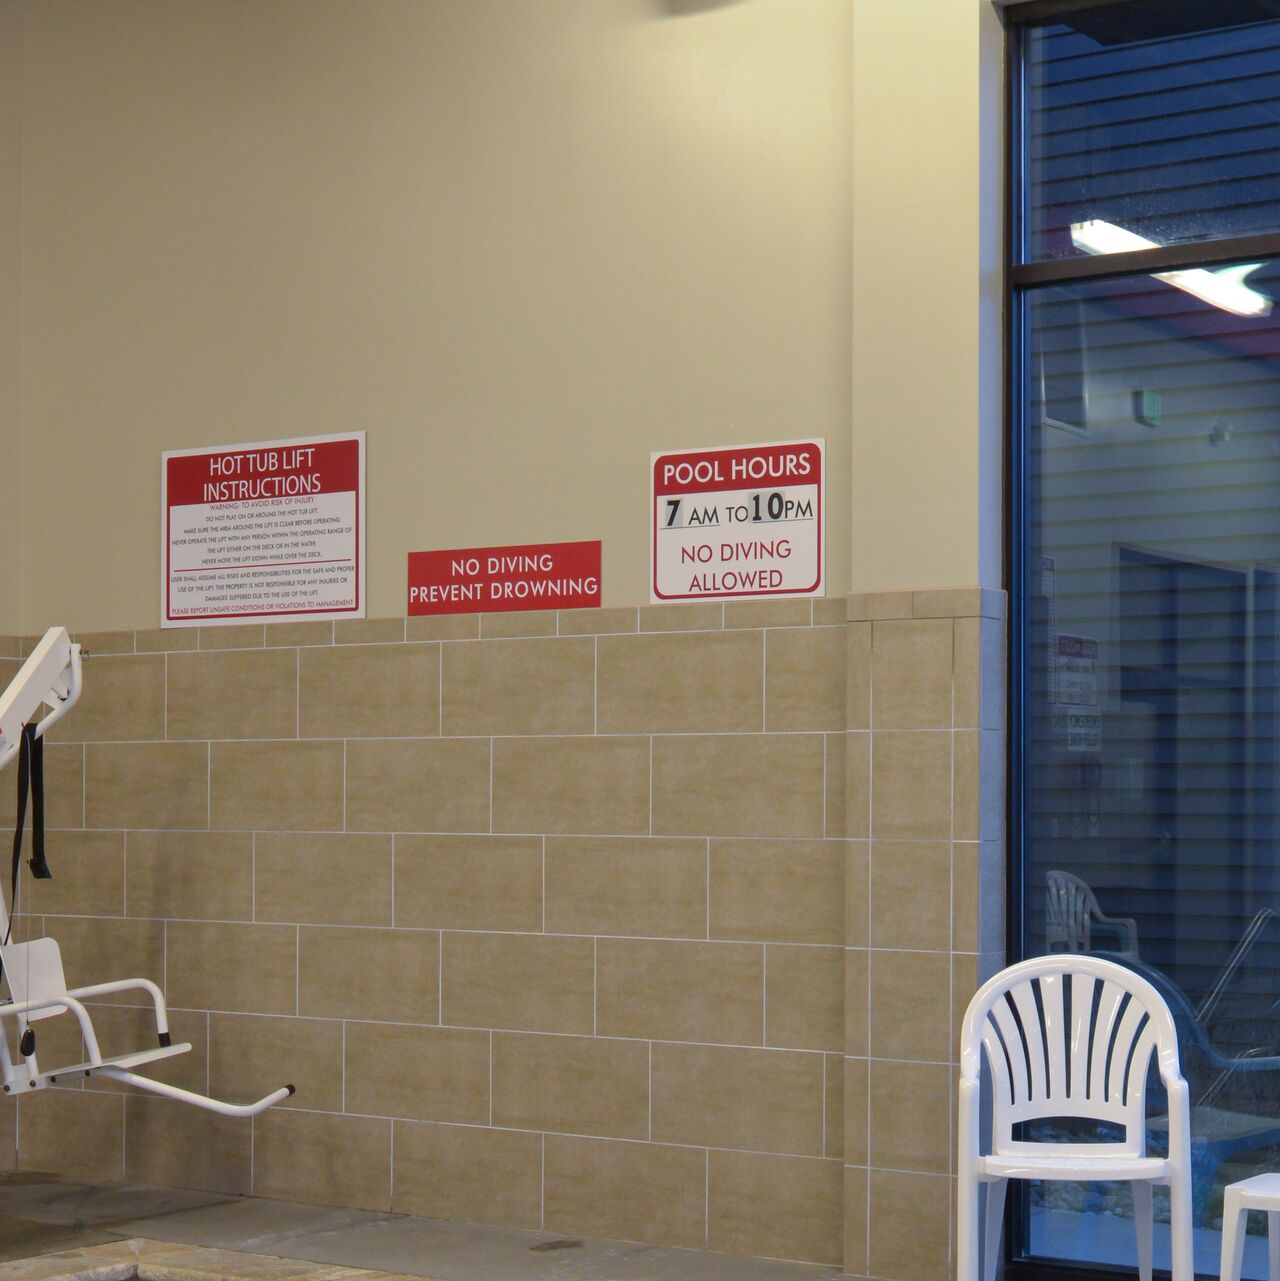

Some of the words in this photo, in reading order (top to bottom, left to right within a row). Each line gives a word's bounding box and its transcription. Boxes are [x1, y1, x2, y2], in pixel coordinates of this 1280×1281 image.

[210, 455, 243, 476] HOT
[247, 452, 278, 473] TUB
[283, 448, 315, 470] LIFT
[664, 460, 724, 486] POOL
[731, 454, 811, 480] HOURS
[204, 474, 321, 502] INSTRUCTIONS
[251, 500, 269, 508] AVOID
[255, 511, 276, 519] AROUND
[666, 500, 682, 527] 7
[688, 506, 720, 526] AM
[726, 505, 749, 523] TO
[300, 528, 327, 537] OPERATING
[681, 546, 713, 564] NO
[720, 540, 792, 562] DIVING
[251, 569, 291, 577] RESPONSIBILITIES
[451, 558, 479, 576] NO
[488, 554, 554, 575] DIVING
[410, 582, 482, 604] PREVENT
[490, 578, 598, 599] DROWNING
[688, 570, 783, 592] ALLOWED
[231, 604, 264, 612] CONDITIONS
